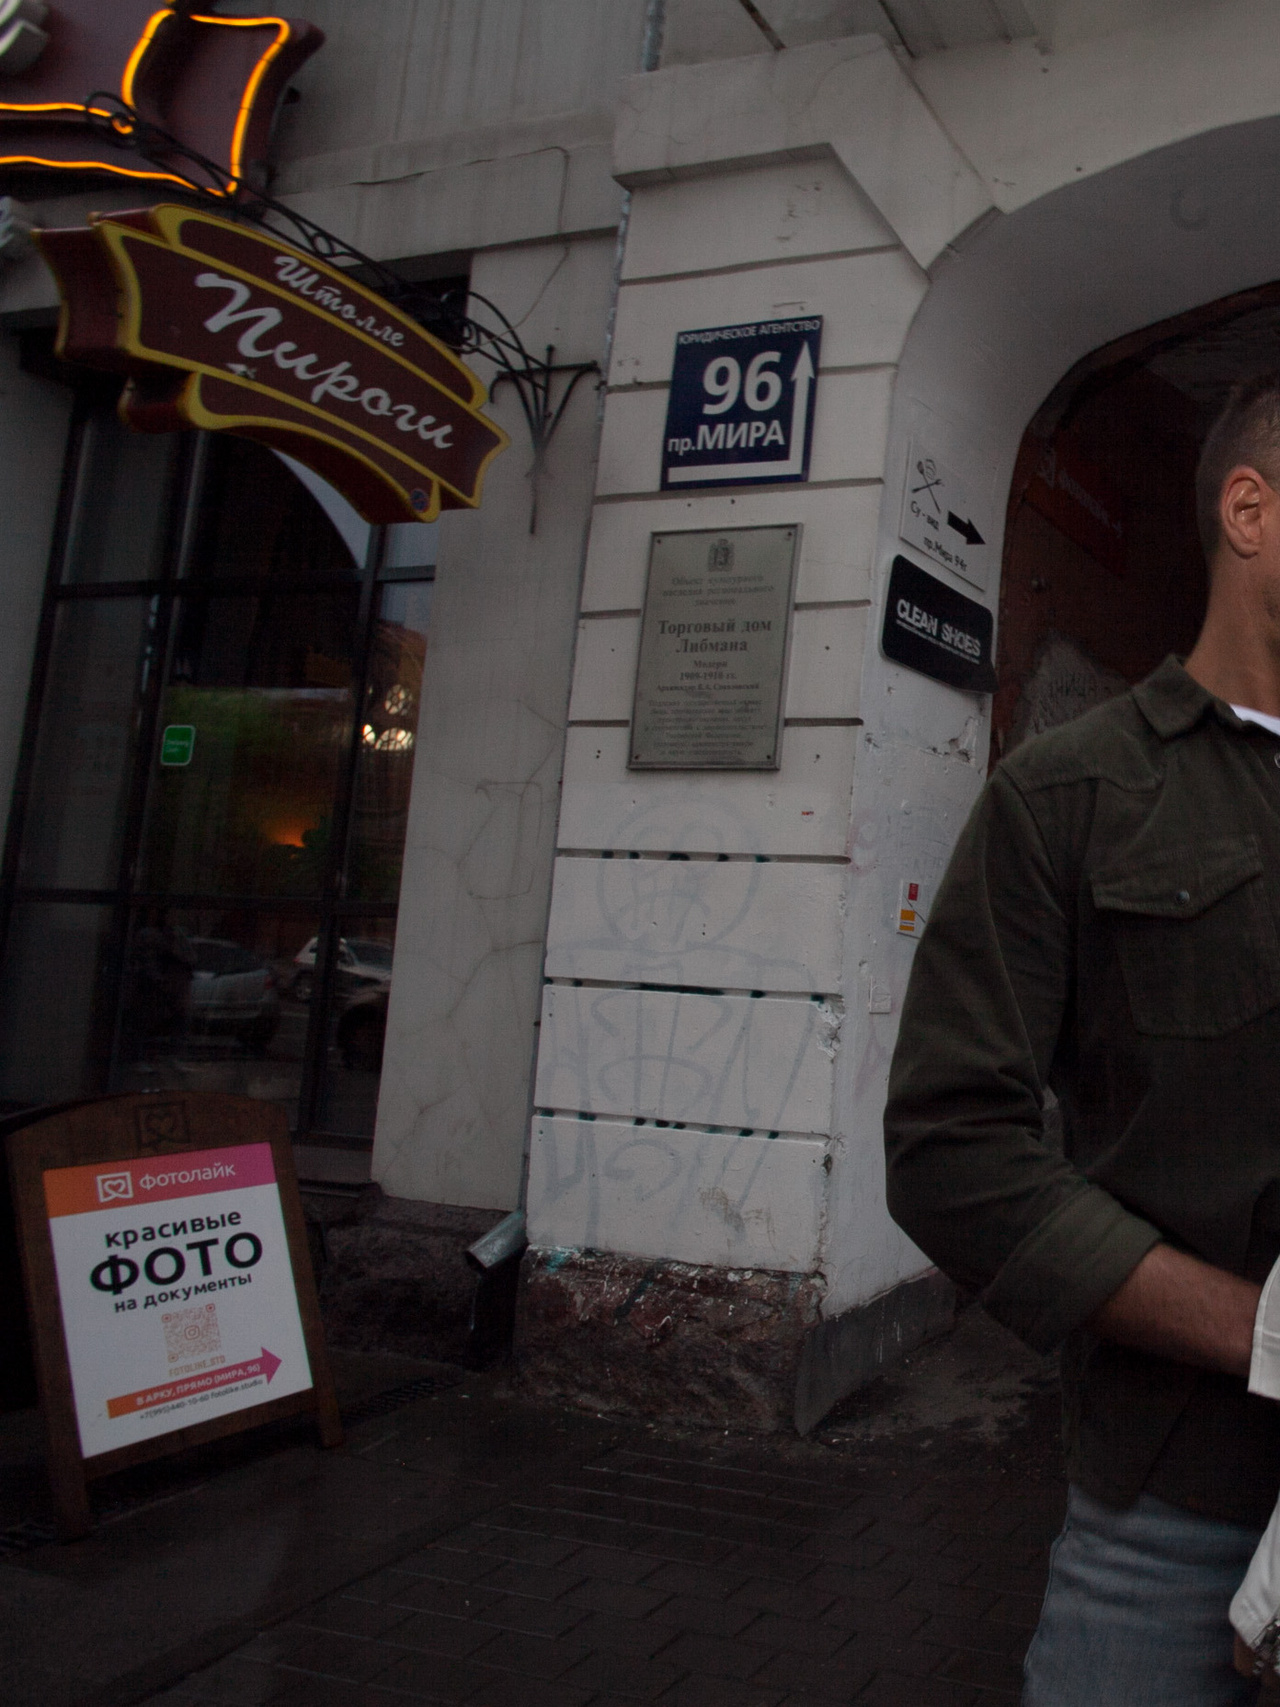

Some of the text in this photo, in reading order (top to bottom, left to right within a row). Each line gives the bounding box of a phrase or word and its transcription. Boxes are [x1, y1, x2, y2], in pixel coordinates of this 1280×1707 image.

[273, 255, 405, 347] Штолле
[678, 320, 821, 345] ЮРИДИЧЕСКОЕ АГЕНТСТВО
[194, 273, 454, 450] Пироги
[702, 350, 783, 416] 96
[658, 618, 772, 638] Торговый дом
[675, 638, 748, 653] Либмана
[896, 598, 938, 637] CLEAN
[940, 622, 981, 658] SHOES
[139, 1162, 236, 1190] Фотолайк
[105, 1212, 242, 1250] красивые
[90, 1232, 263, 1295] ФОТО
[114, 1274, 252, 1313] на документы
[175, 1377, 213, 1394] ПРЯМО
